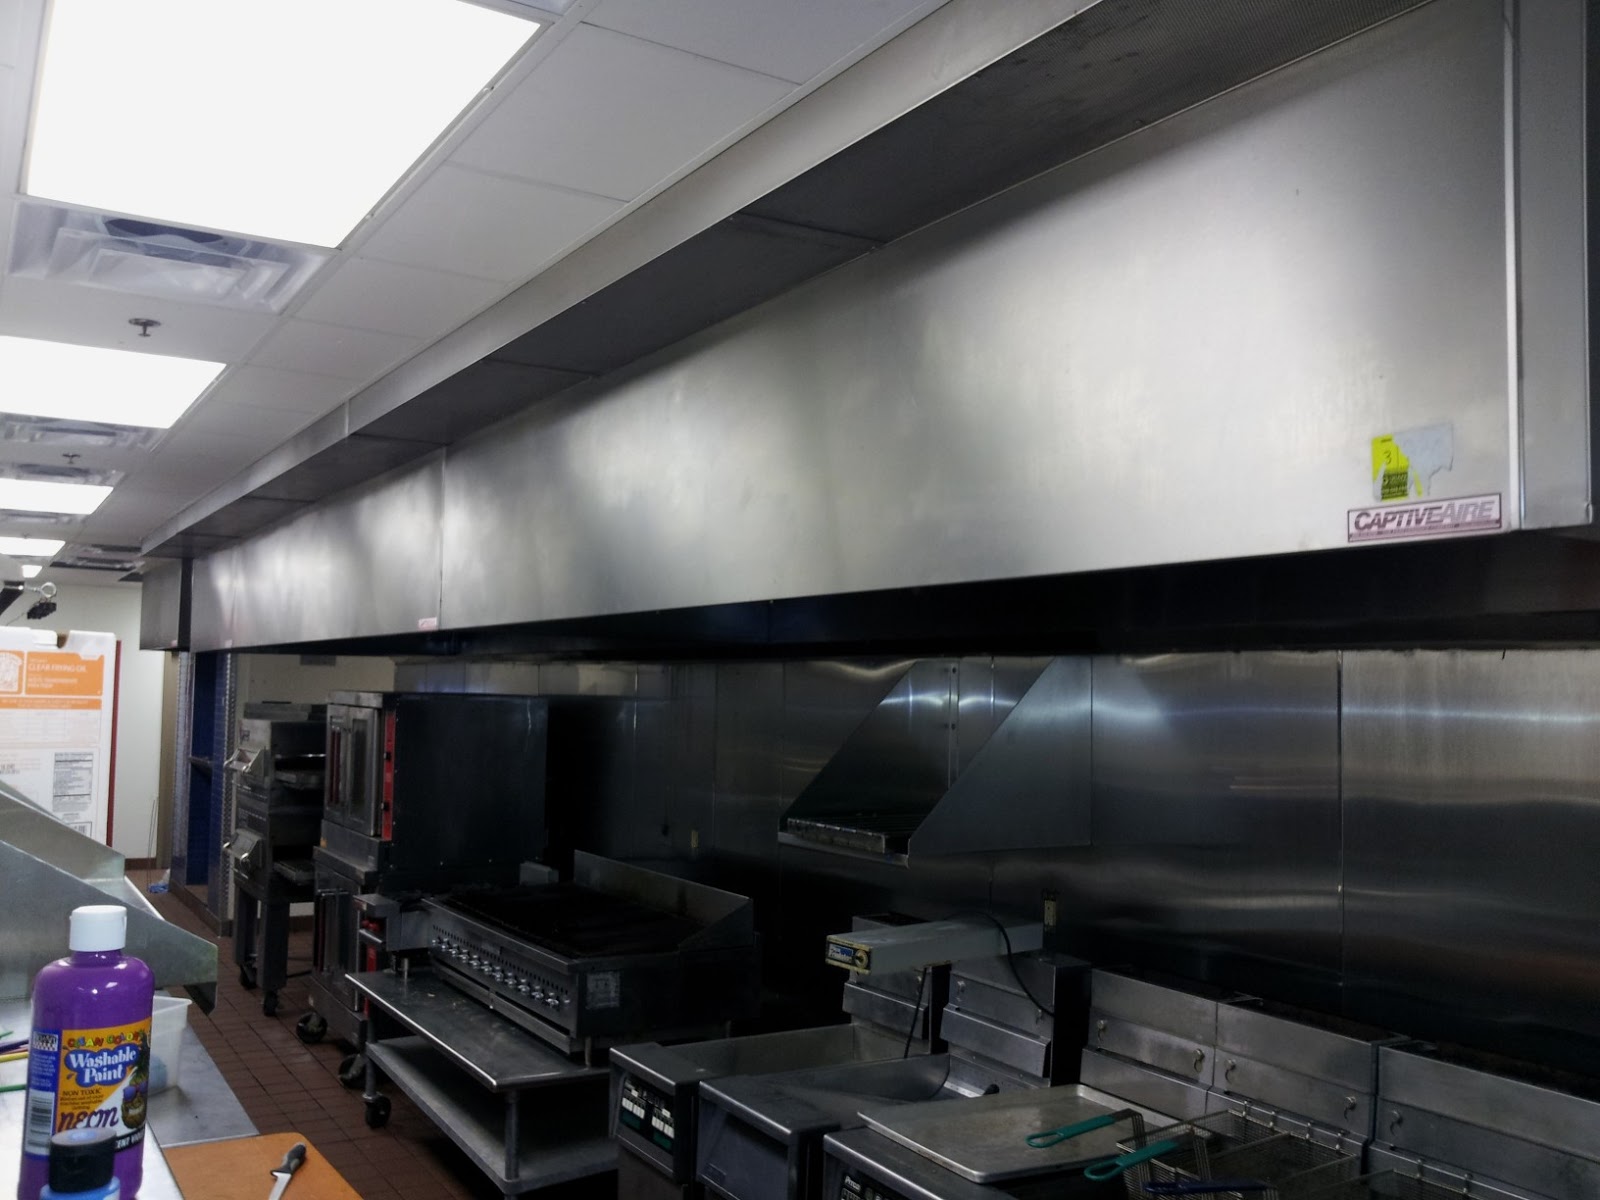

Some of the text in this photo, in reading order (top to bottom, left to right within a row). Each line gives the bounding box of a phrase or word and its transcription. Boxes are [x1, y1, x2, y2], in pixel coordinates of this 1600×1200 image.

[69, 1046, 136, 1068] Washable
[84, 1064, 123, 1083] Paint
[57, 1106, 119, 1132] neon
